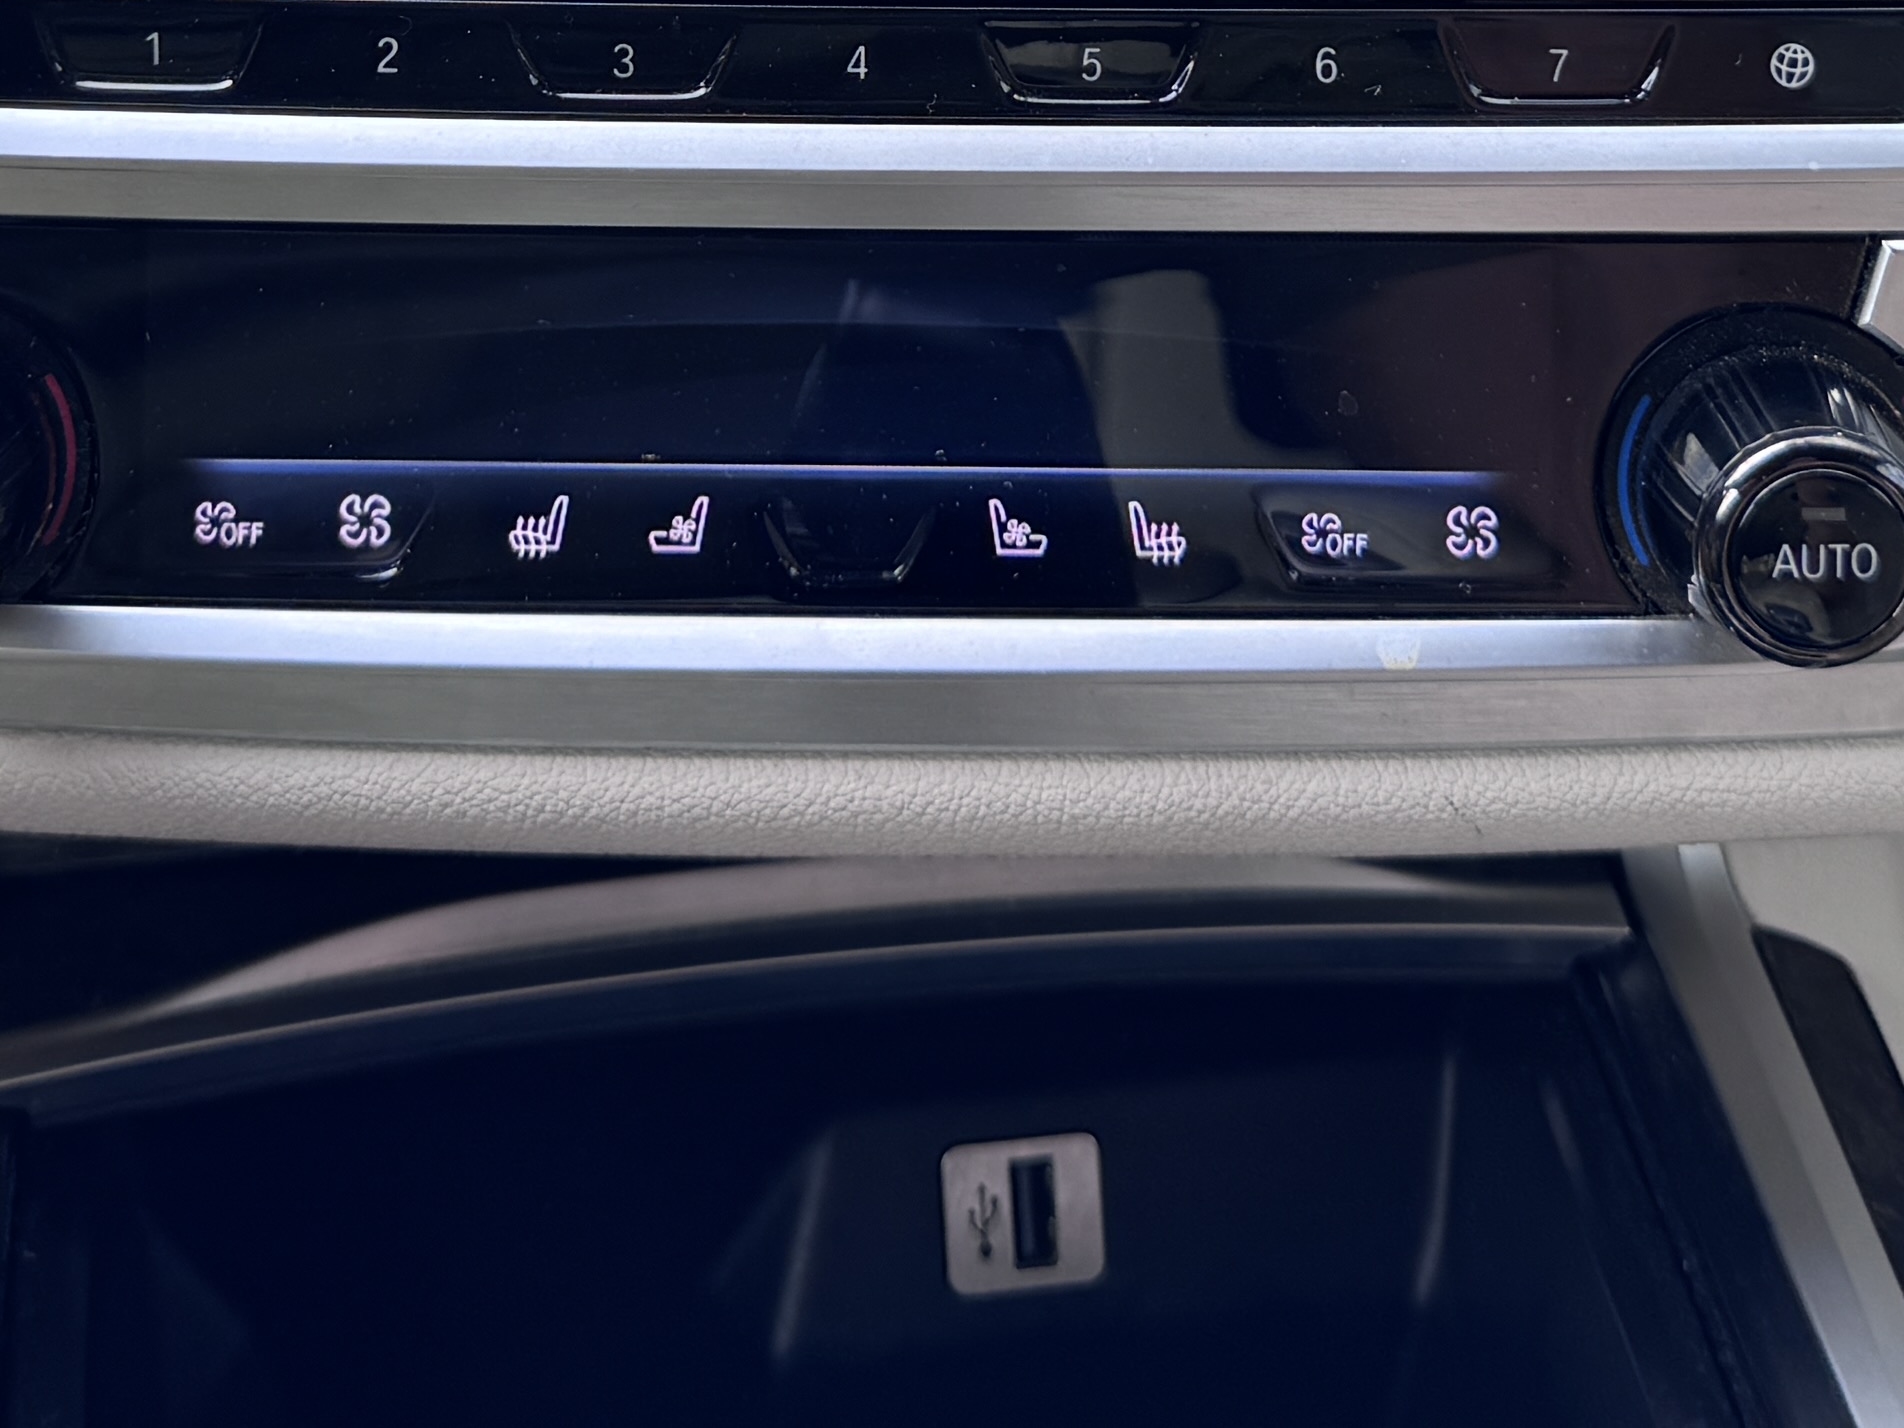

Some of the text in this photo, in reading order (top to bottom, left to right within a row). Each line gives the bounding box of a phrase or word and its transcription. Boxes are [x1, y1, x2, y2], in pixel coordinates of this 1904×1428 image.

[143, 31, 163, 67] 1
[376, 36, 399, 74] 2
[613, 43, 635, 78] 3
[847, 45, 868, 80] 4
[1082, 47, 1102, 81] 5
[1315, 47, 1337, 84] 6
[1549, 48, 1570, 83] 7
[221, 521, 264, 546] OFF
[1327, 532, 1369, 557] OFF
[1771, 542, 1878, 582] AUTO
